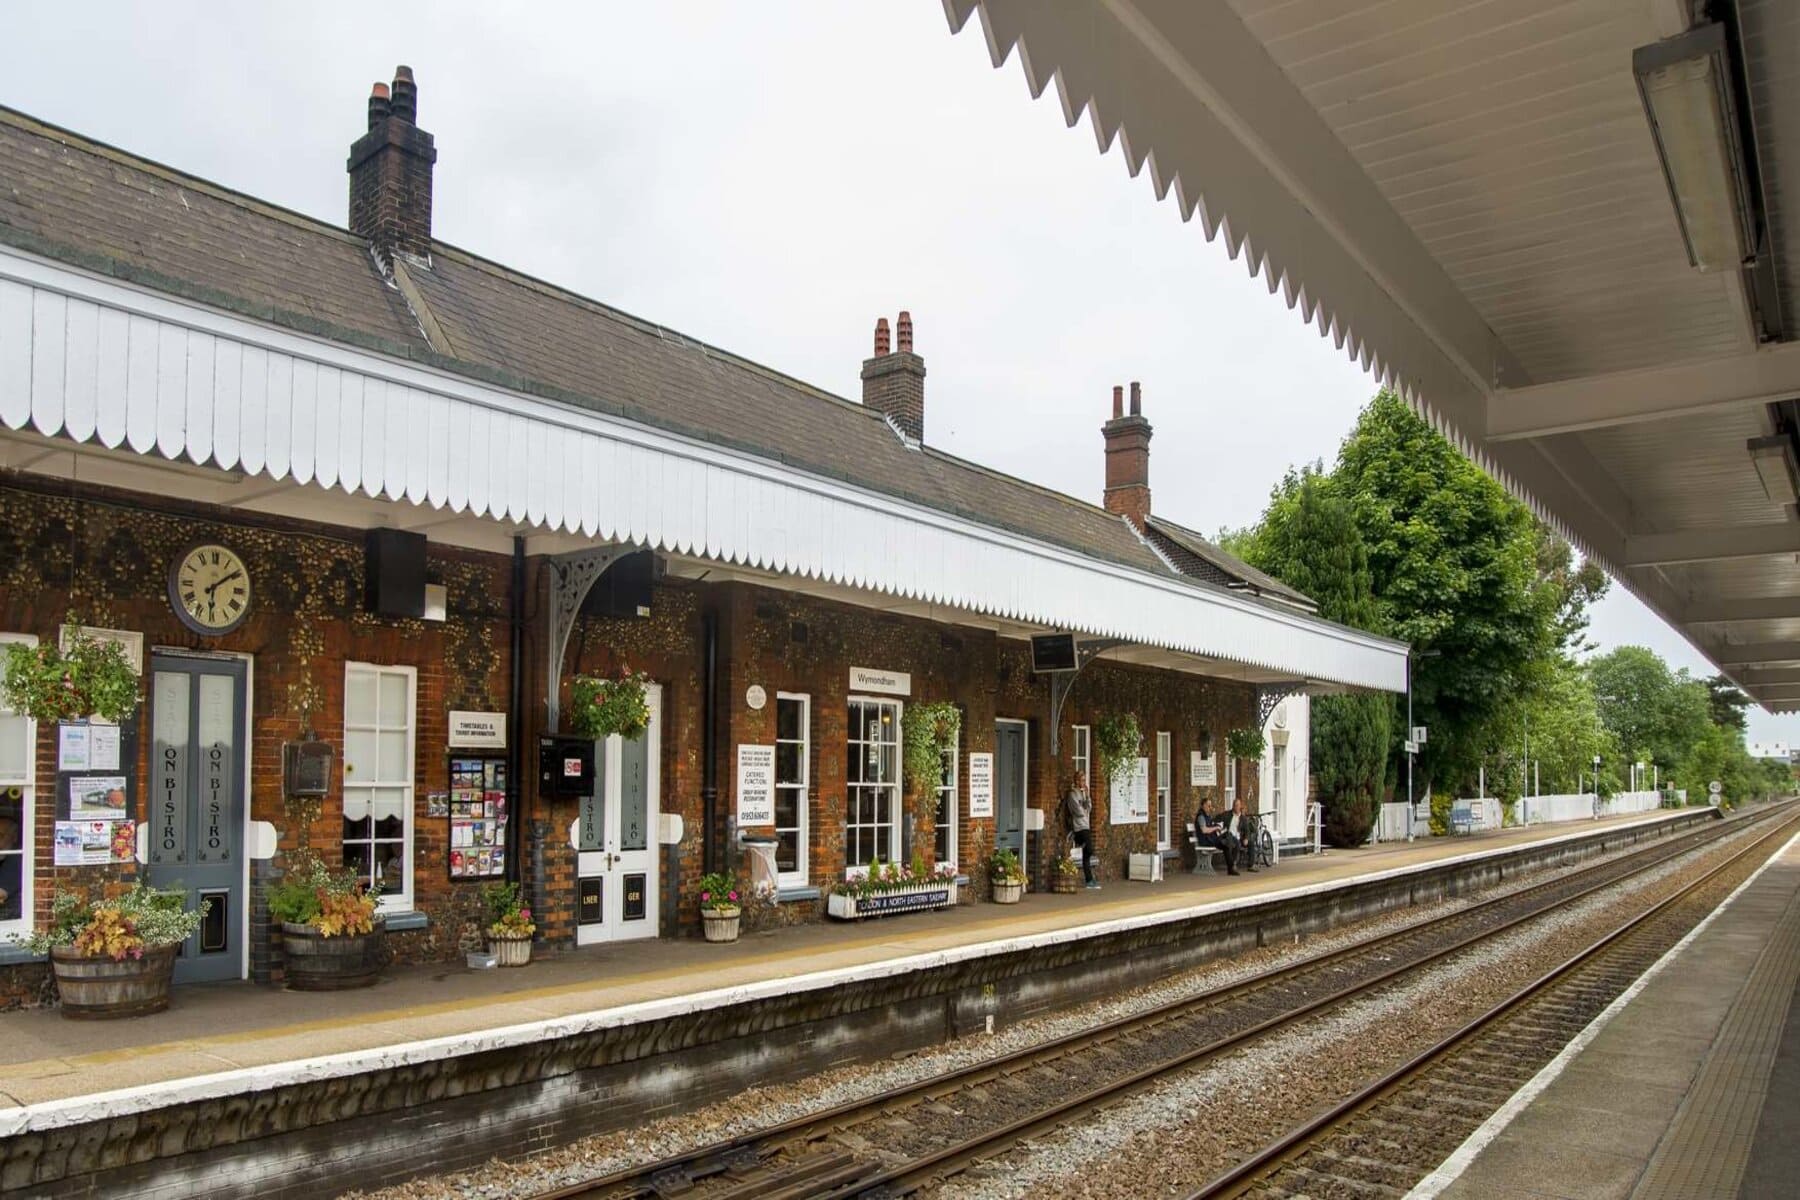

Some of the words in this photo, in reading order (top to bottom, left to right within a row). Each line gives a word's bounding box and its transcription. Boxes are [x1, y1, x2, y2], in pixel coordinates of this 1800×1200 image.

[857, 672, 896, 687] Wymondham
[163, 777, 176, 850] BISTRO
[208, 778, 220, 849] BISTRO
[583, 895, 599, 905] LNER
[627, 892, 640, 901] GER
[889, 897, 907, 906] NORTH
[907, 894, 929, 905] EASTERN
